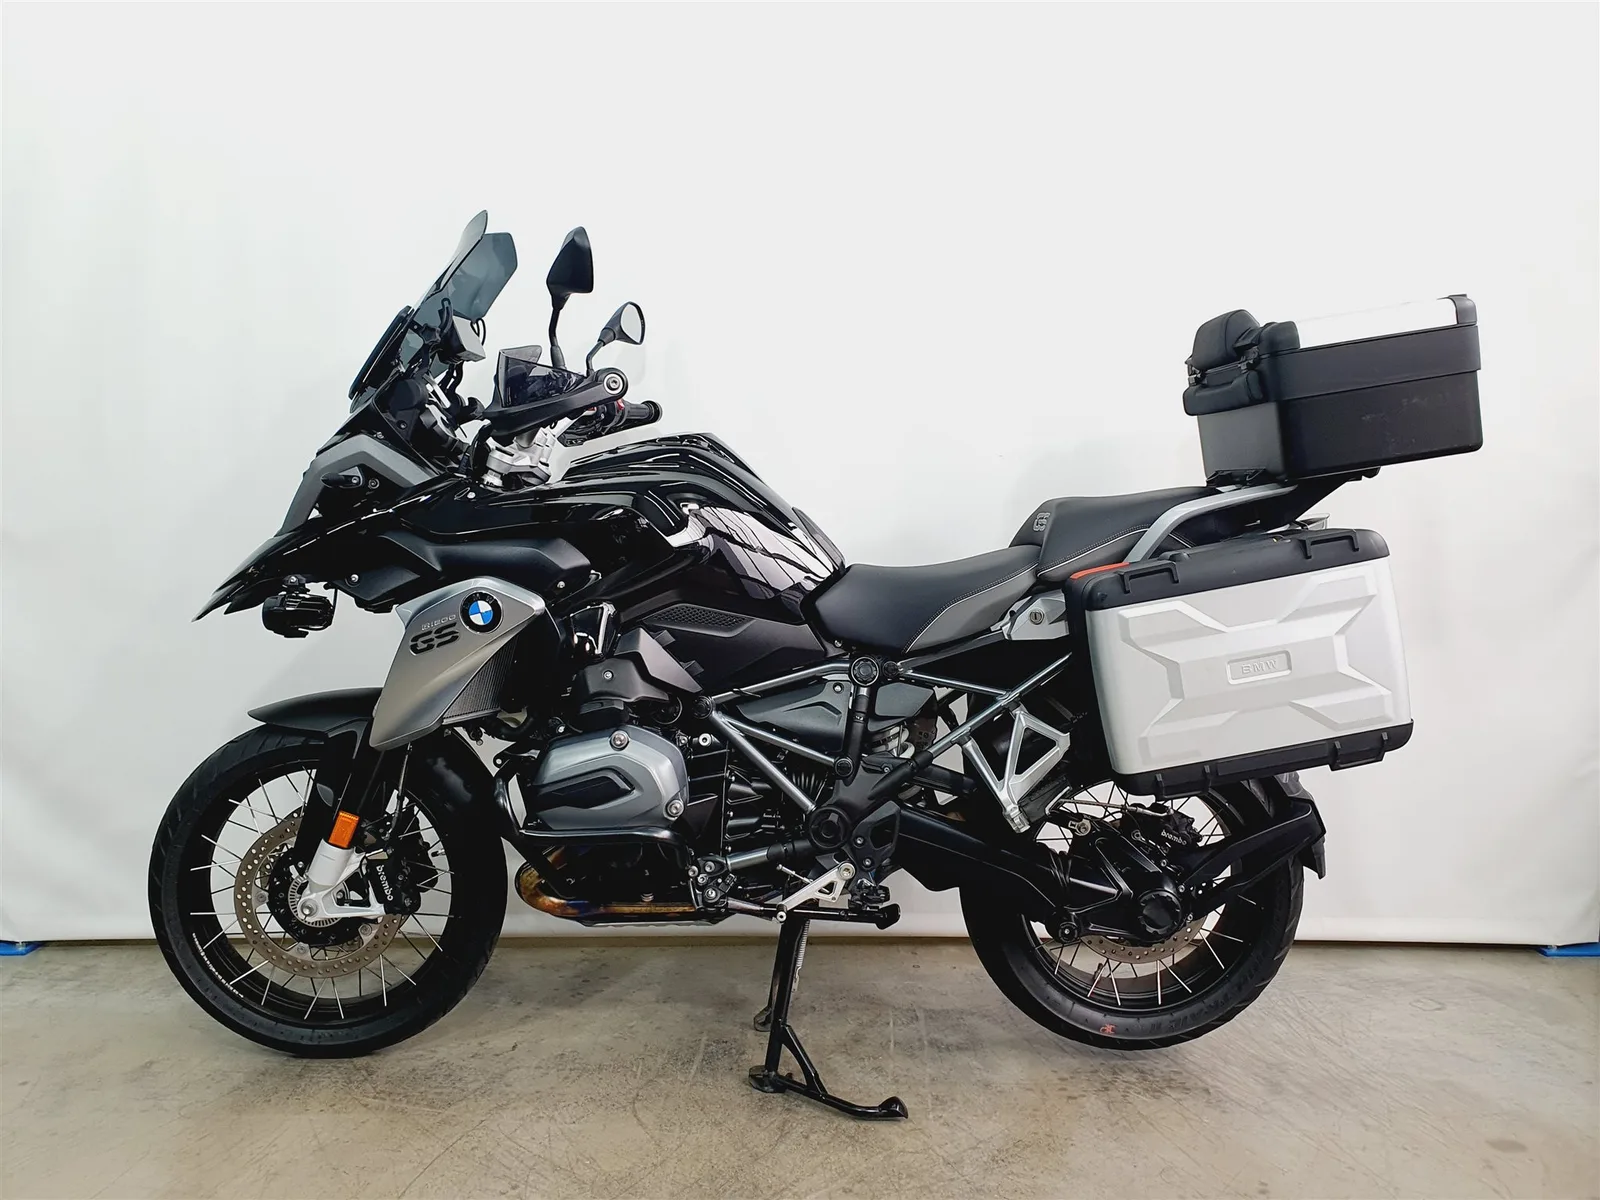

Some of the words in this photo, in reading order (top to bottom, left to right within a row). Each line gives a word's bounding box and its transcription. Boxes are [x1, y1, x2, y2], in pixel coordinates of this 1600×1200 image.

[1033, 512, 1050, 531] GS
[409, 622, 459, 655] GS
[1241, 659, 1277, 675] BMW
[1161, 829, 1187, 846] brembo
[376, 864, 393, 901] brembo
